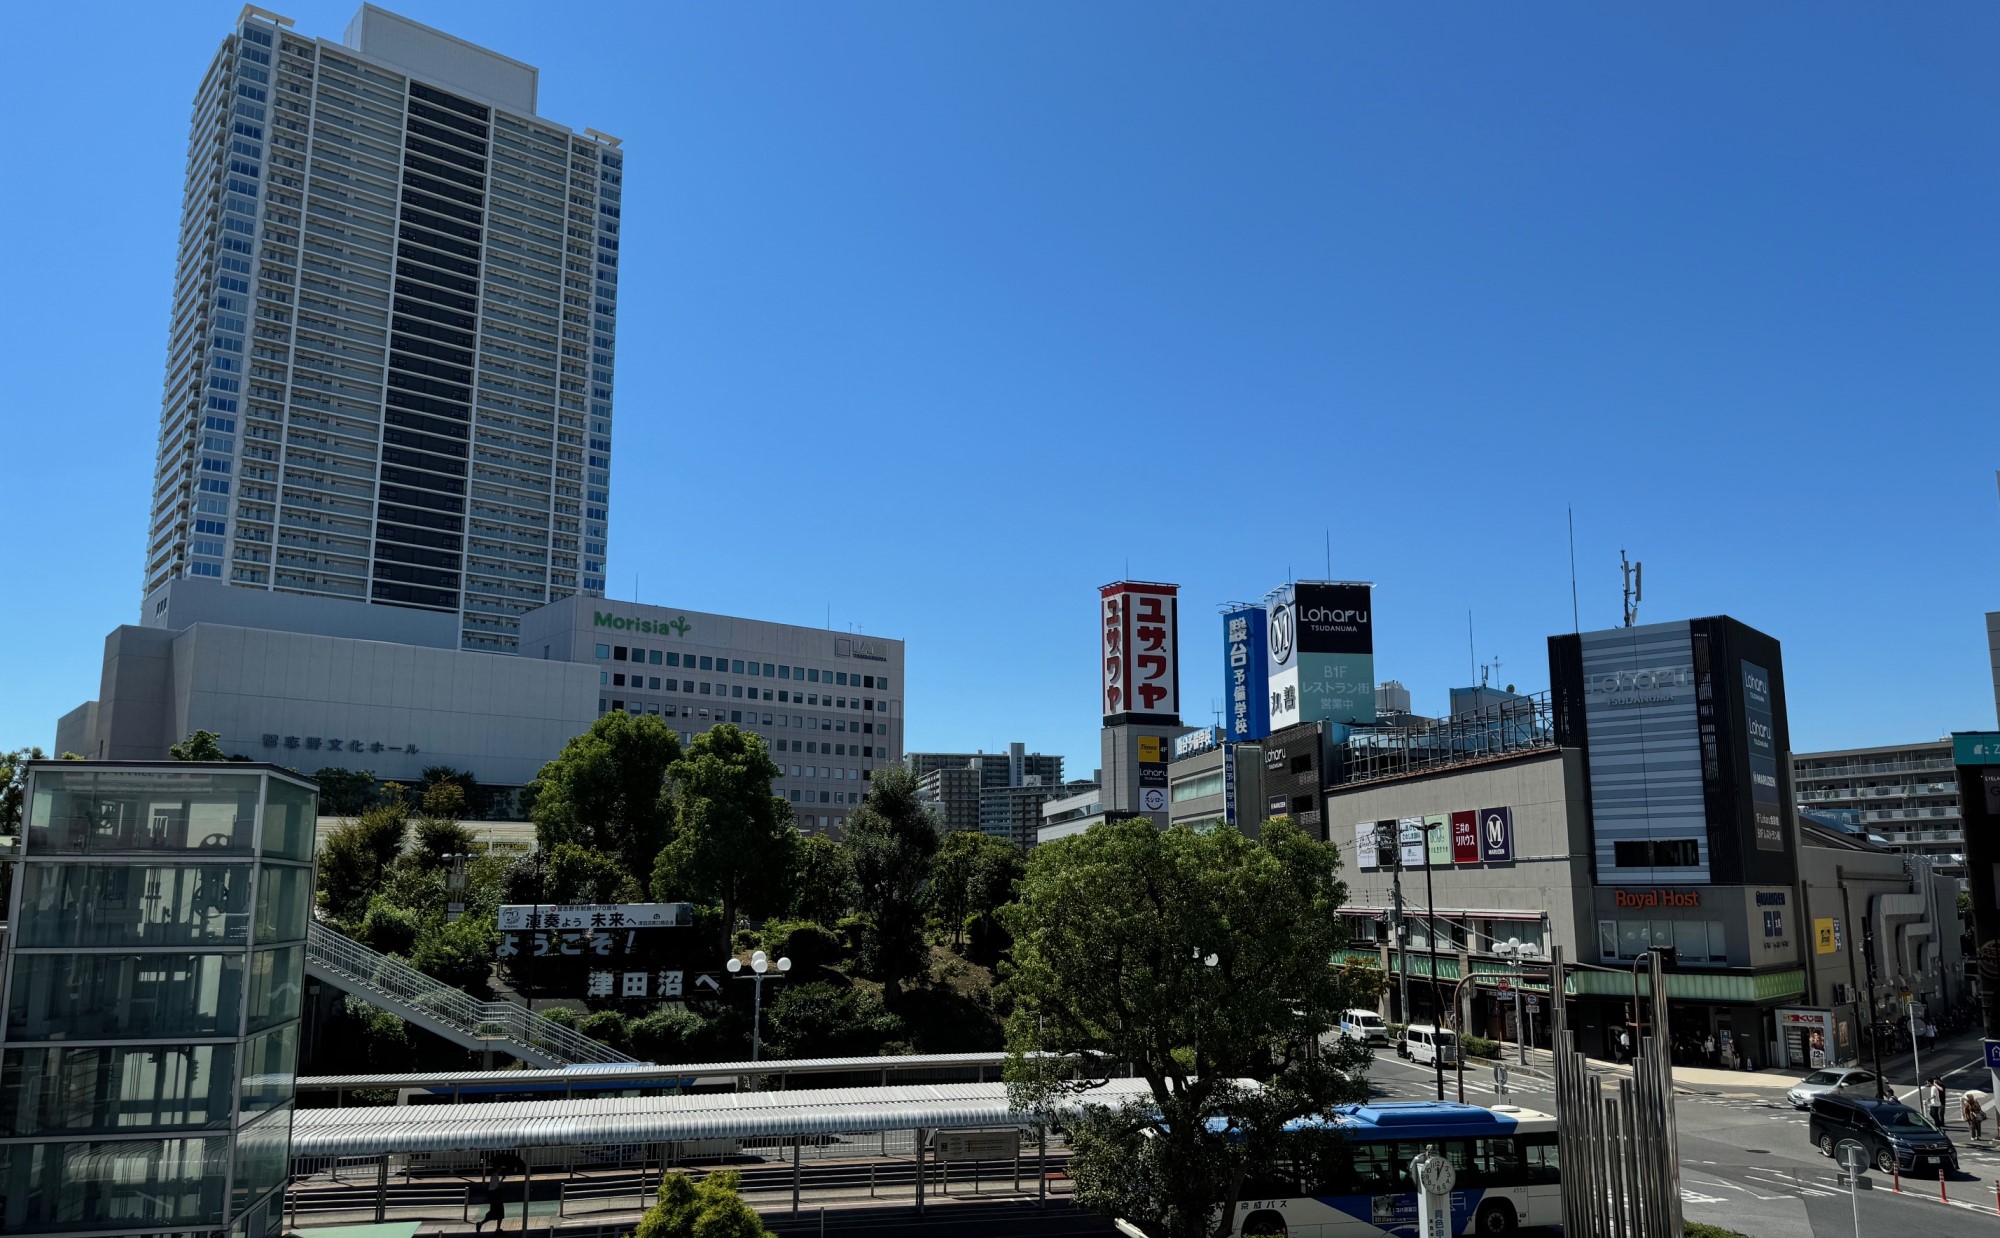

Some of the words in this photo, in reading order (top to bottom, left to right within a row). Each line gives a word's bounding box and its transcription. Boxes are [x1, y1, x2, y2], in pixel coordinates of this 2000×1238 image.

[1299, 605, 1367, 623] Loharu
[593, 611, 670, 636] Morisia
[1310, 624, 1357, 633] TSUDANUMA
[1105, 599, 1122, 712] ユザワヤ
[1136, 597, 1167, 709] ユザワヤ
[1227, 616, 1248, 735] 駿台予備学校
[1323, 665, 1347, 678] B1F
[1302, 681, 1370, 695] レストラン街
[1590, 668, 1689, 695] Loharu
[1744, 670, 1767, 694] Loharu
[1270, 684, 1296, 716] 丸善
[1320, 698, 1354, 711] 営業中
[1748, 717, 1771, 740] Loharu
[262, 733, 420, 755] 習志野文化ホール
[1140, 743, 1157, 751] Times
[1264, 748, 1287, 764] Loharu
[1139, 768, 1168, 776] Loharu
[1455, 822, 1470, 834] 三井の
[1455, 834, 1476, 847] リハウス
[1614, 889, 1658, 909] Royal
[1662, 889, 1700, 907] Host
[590, 912, 637, 928] 未来へ
[586, 968, 723, 998] 津田沼へ
[1240, 1200, 1287, 1210] 京成バス
